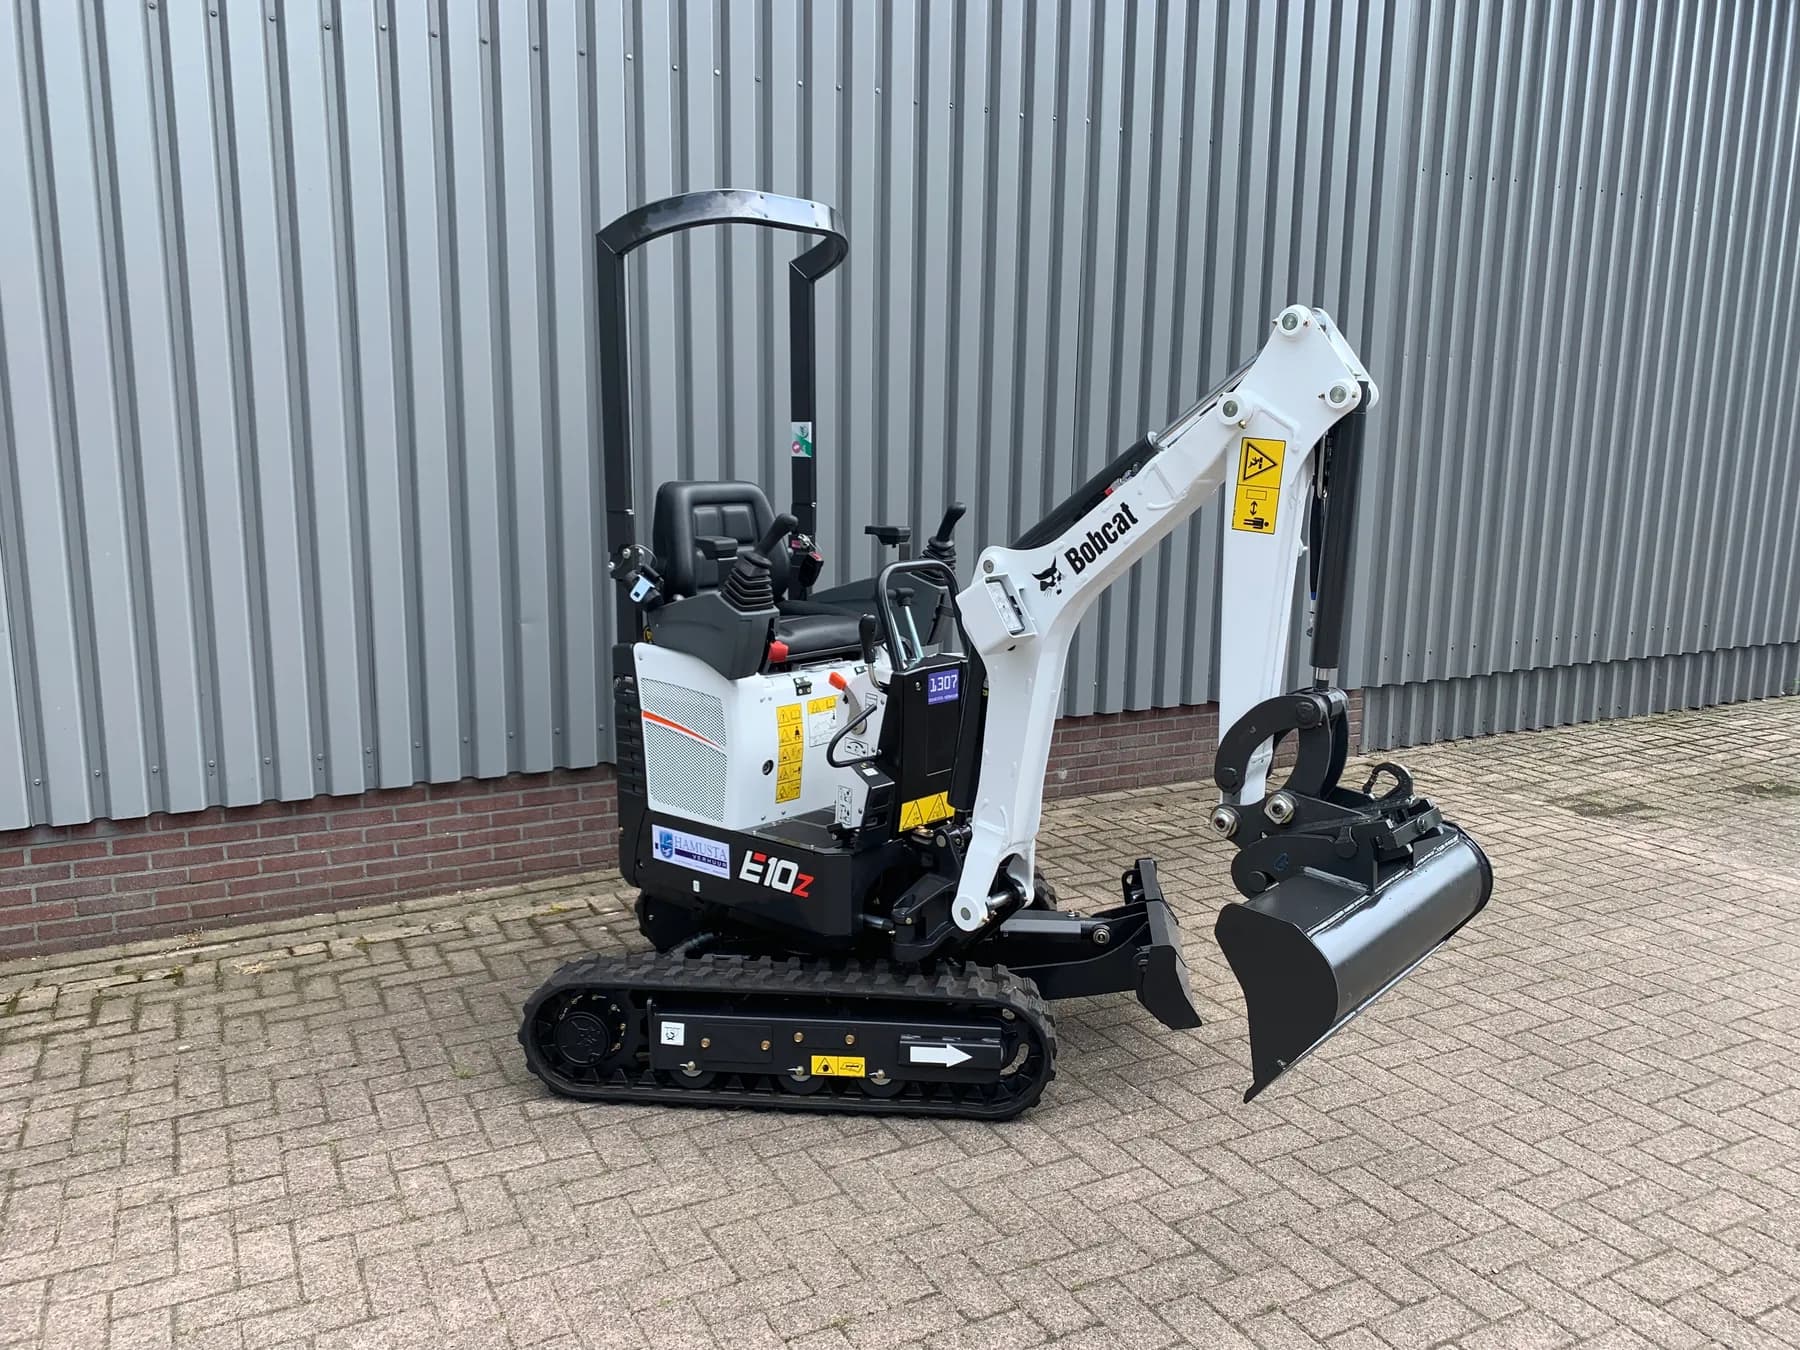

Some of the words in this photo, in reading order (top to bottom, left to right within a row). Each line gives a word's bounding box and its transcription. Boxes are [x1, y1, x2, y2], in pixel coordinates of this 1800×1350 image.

[1064, 502, 1139, 575] Bobcat
[930, 674, 958, 692] 1307
[674, 835, 728, 861] HAMUSTA
